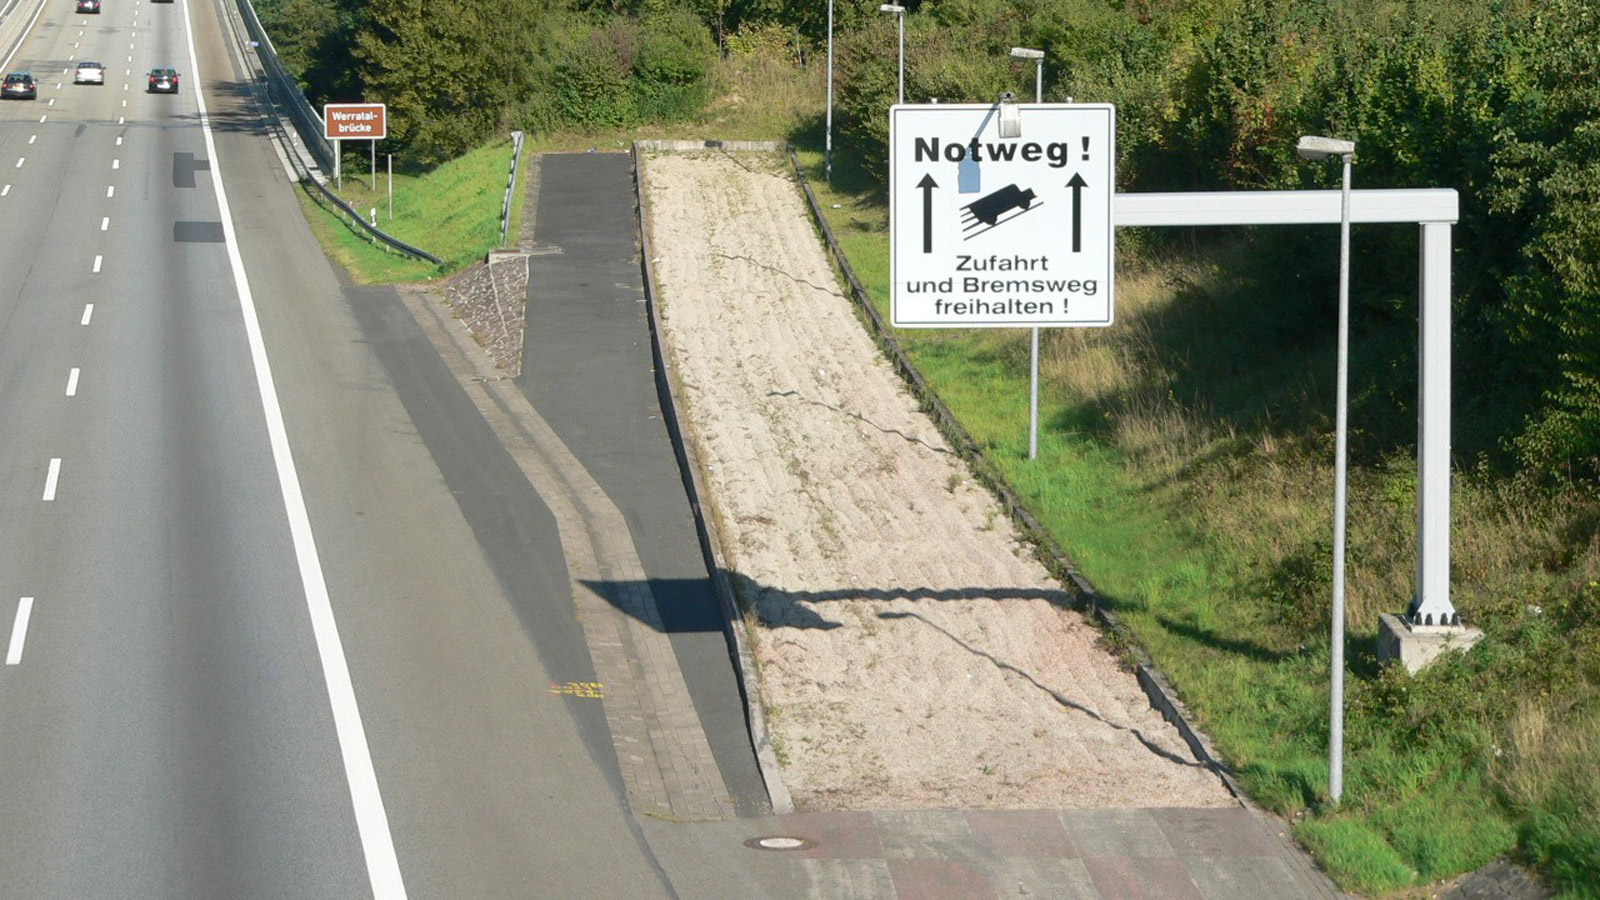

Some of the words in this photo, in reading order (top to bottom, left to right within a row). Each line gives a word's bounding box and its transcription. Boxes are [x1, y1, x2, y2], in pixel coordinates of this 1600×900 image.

[332, 111, 378, 121] Werratal-
[338, 123, 372, 132] brücke
[914, 137, 1068, 168] Notweg
[1081, 136, 1091, 161] !
[956, 255, 1049, 271] Zufahrt
[906, 277, 953, 293] und
[963, 277, 1098, 296] Bremsweg
[934, 299, 1053, 314] freihalten
[1063, 298, 1069, 314] !
